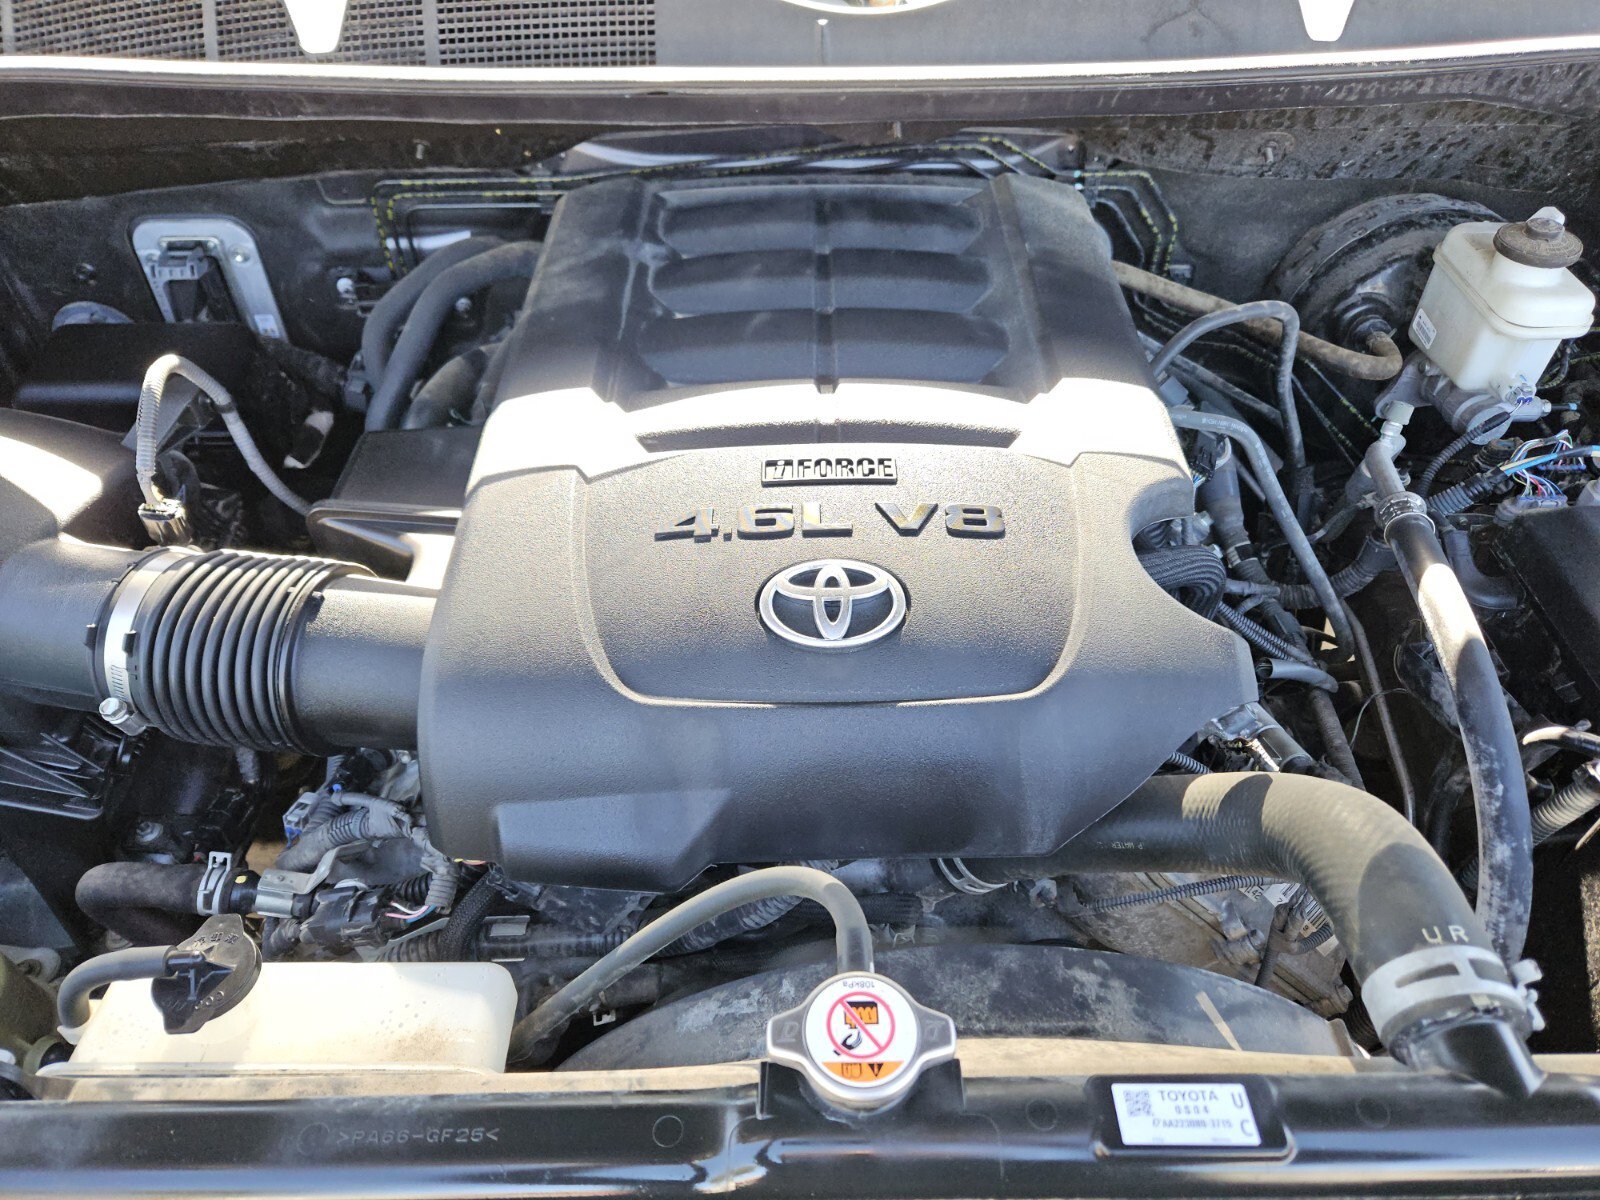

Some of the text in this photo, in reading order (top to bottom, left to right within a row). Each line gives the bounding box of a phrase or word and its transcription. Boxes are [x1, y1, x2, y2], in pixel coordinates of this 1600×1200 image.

[654, 502, 1006, 543] 4.6L V8
[1158, 1090, 1219, 1102] TOYOTA
